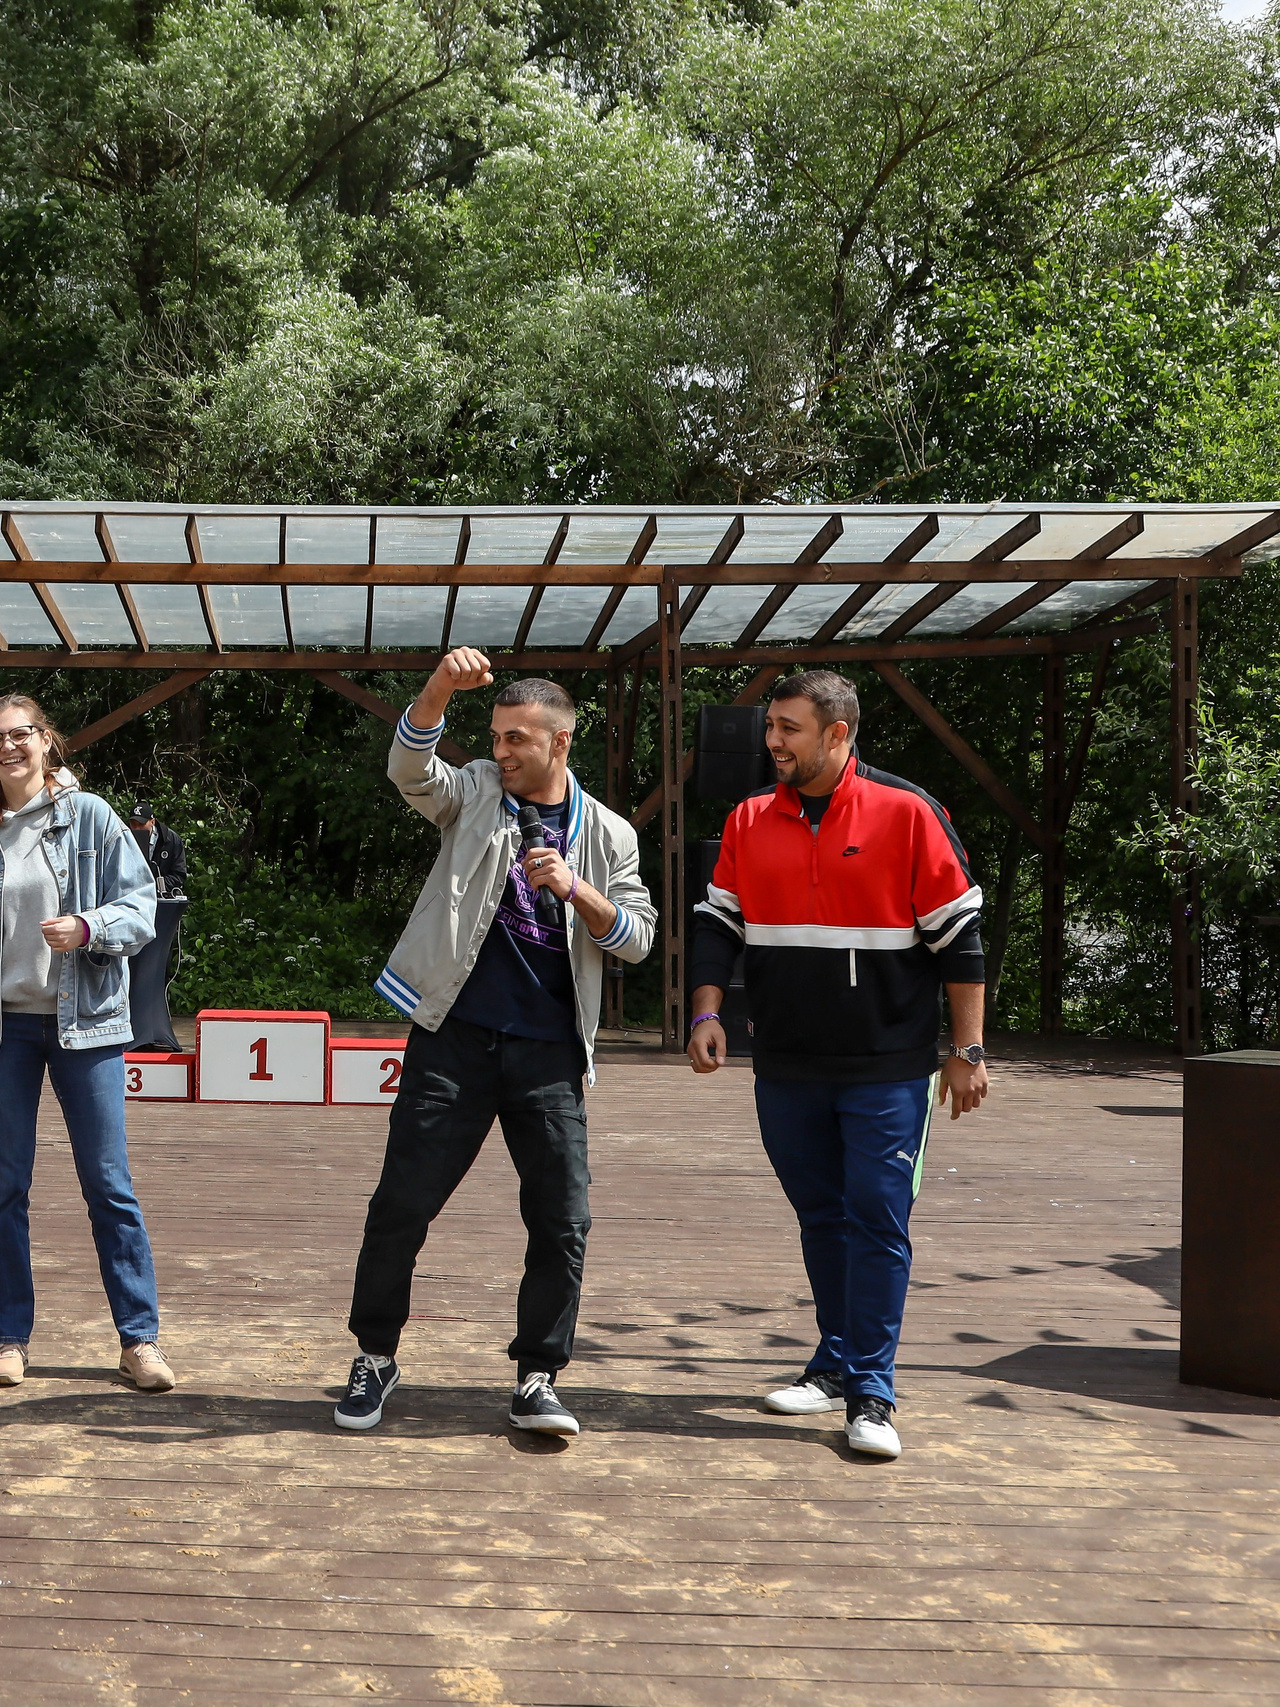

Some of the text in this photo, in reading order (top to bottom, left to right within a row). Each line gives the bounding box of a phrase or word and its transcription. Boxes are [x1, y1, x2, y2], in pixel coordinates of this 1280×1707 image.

[249, 1038, 273, 1081] 1
[379, 1057, 403, 1093] 2
[127, 1068, 143, 1092] 3
